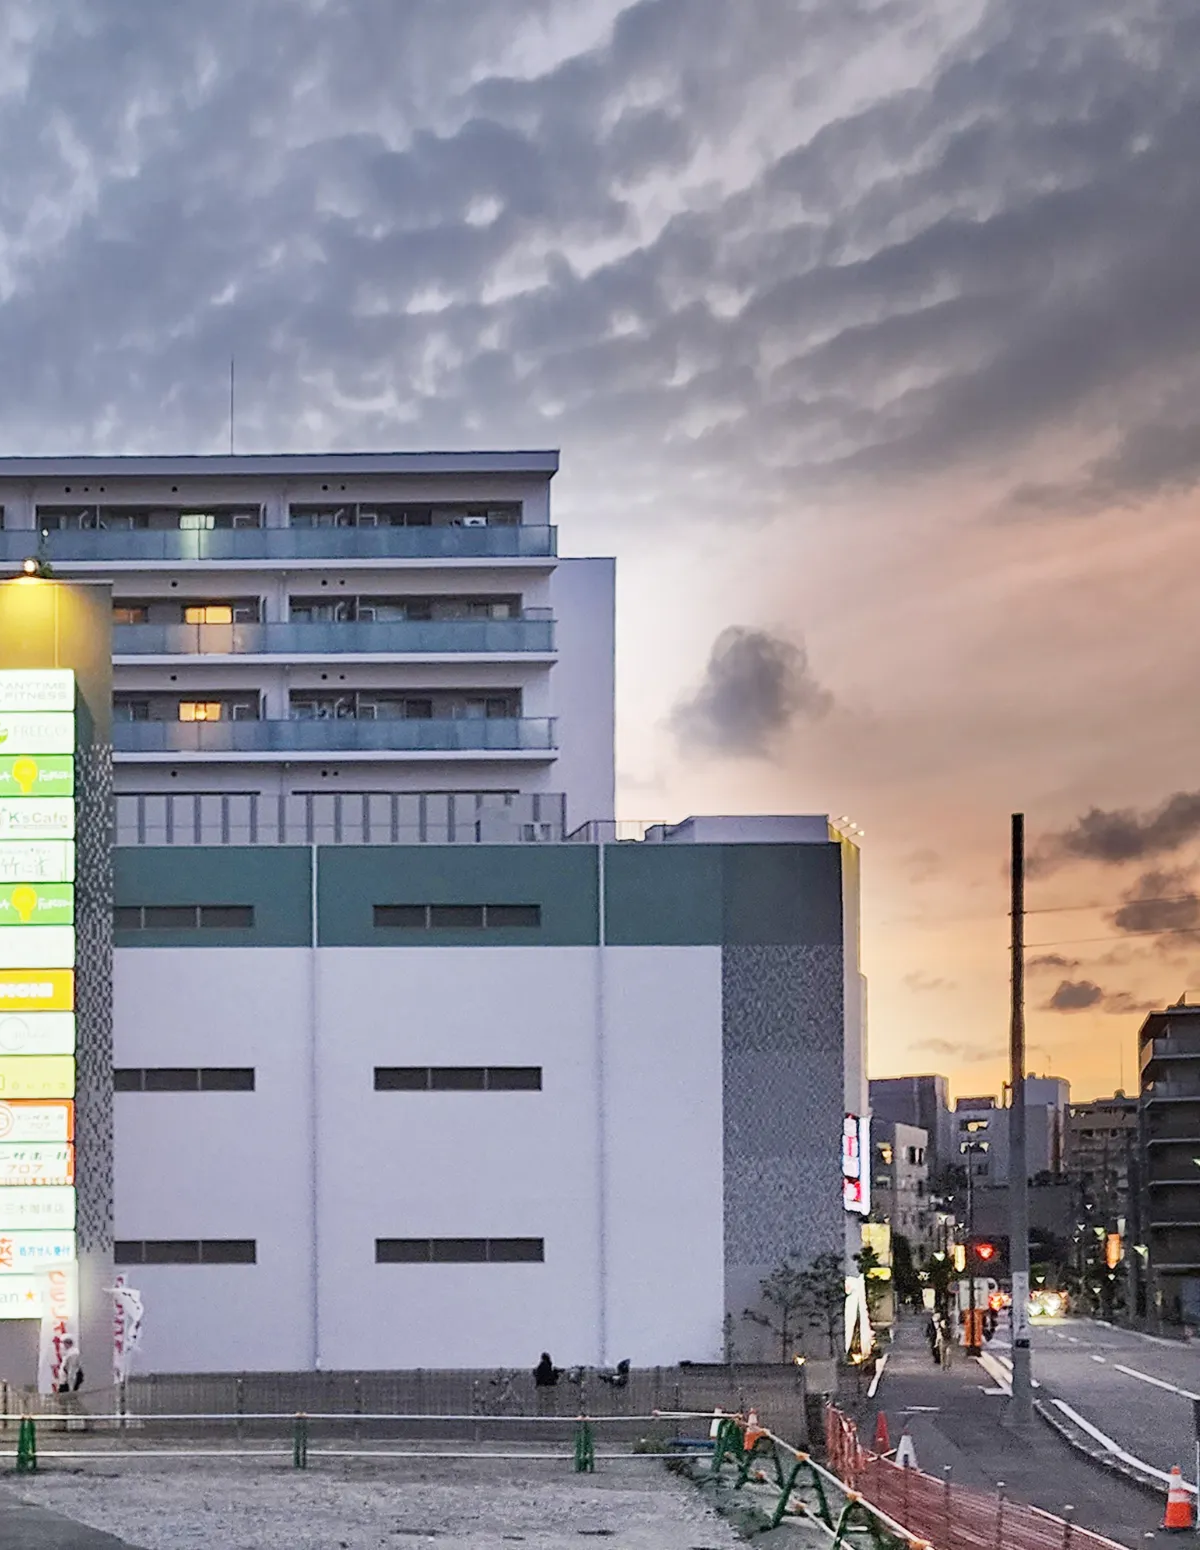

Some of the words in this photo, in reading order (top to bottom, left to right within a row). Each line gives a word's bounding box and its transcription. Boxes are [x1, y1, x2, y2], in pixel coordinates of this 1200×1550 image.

[5, 681, 67, 690] ANYTIME
[4, 691, 67, 701] FITNESS
[7, 1163, 44, 1174] 707
